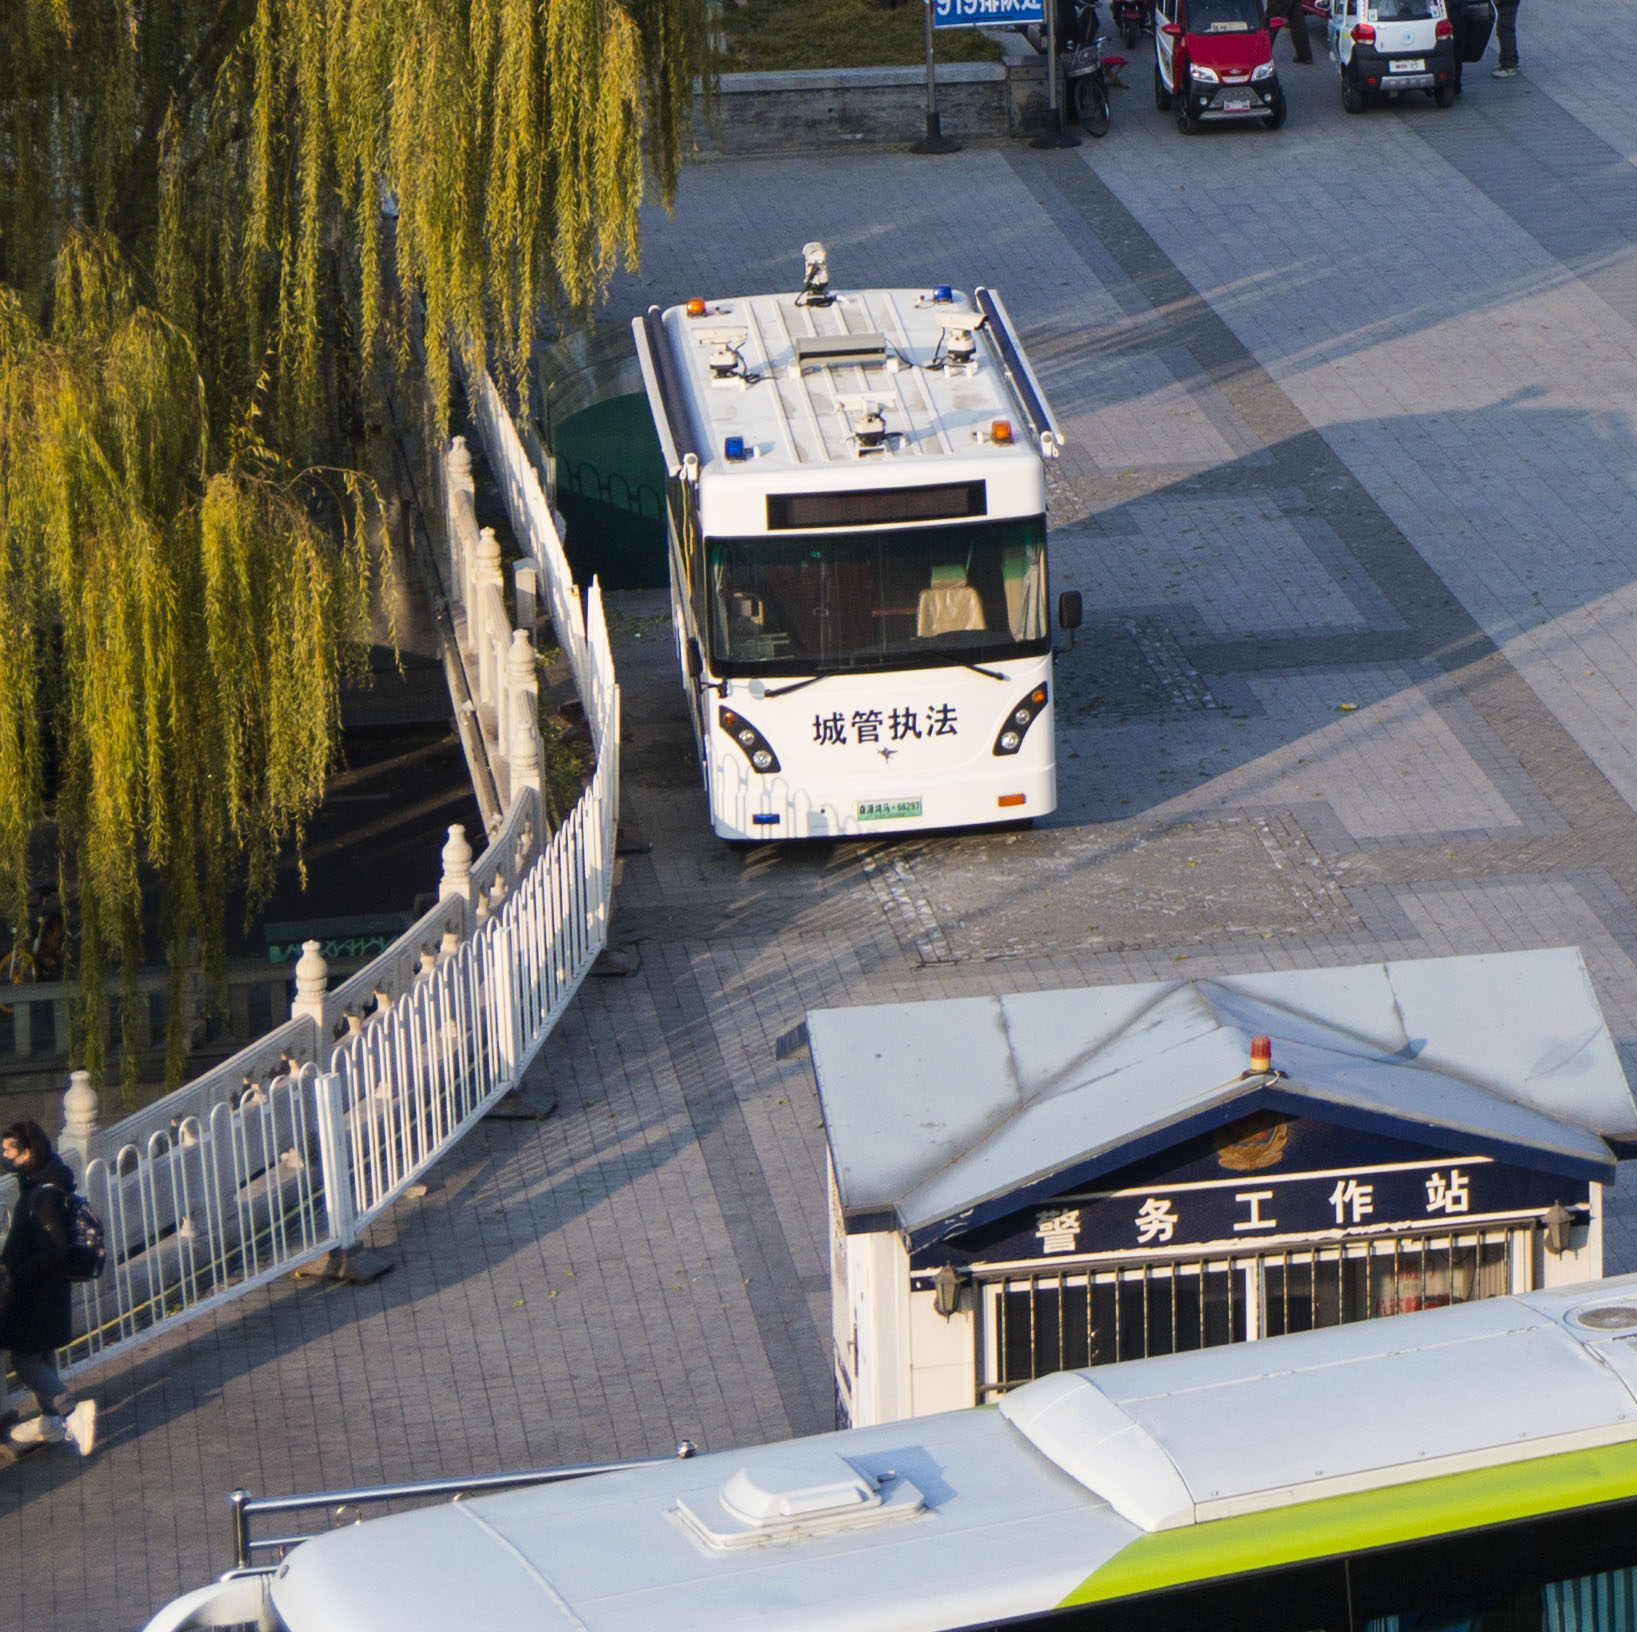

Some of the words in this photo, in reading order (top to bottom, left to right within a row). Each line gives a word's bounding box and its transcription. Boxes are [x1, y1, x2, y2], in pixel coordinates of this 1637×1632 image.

[812, 702, 958, 746] 城管执法
[1035, 1169, 1470, 1254] 警务工作站
